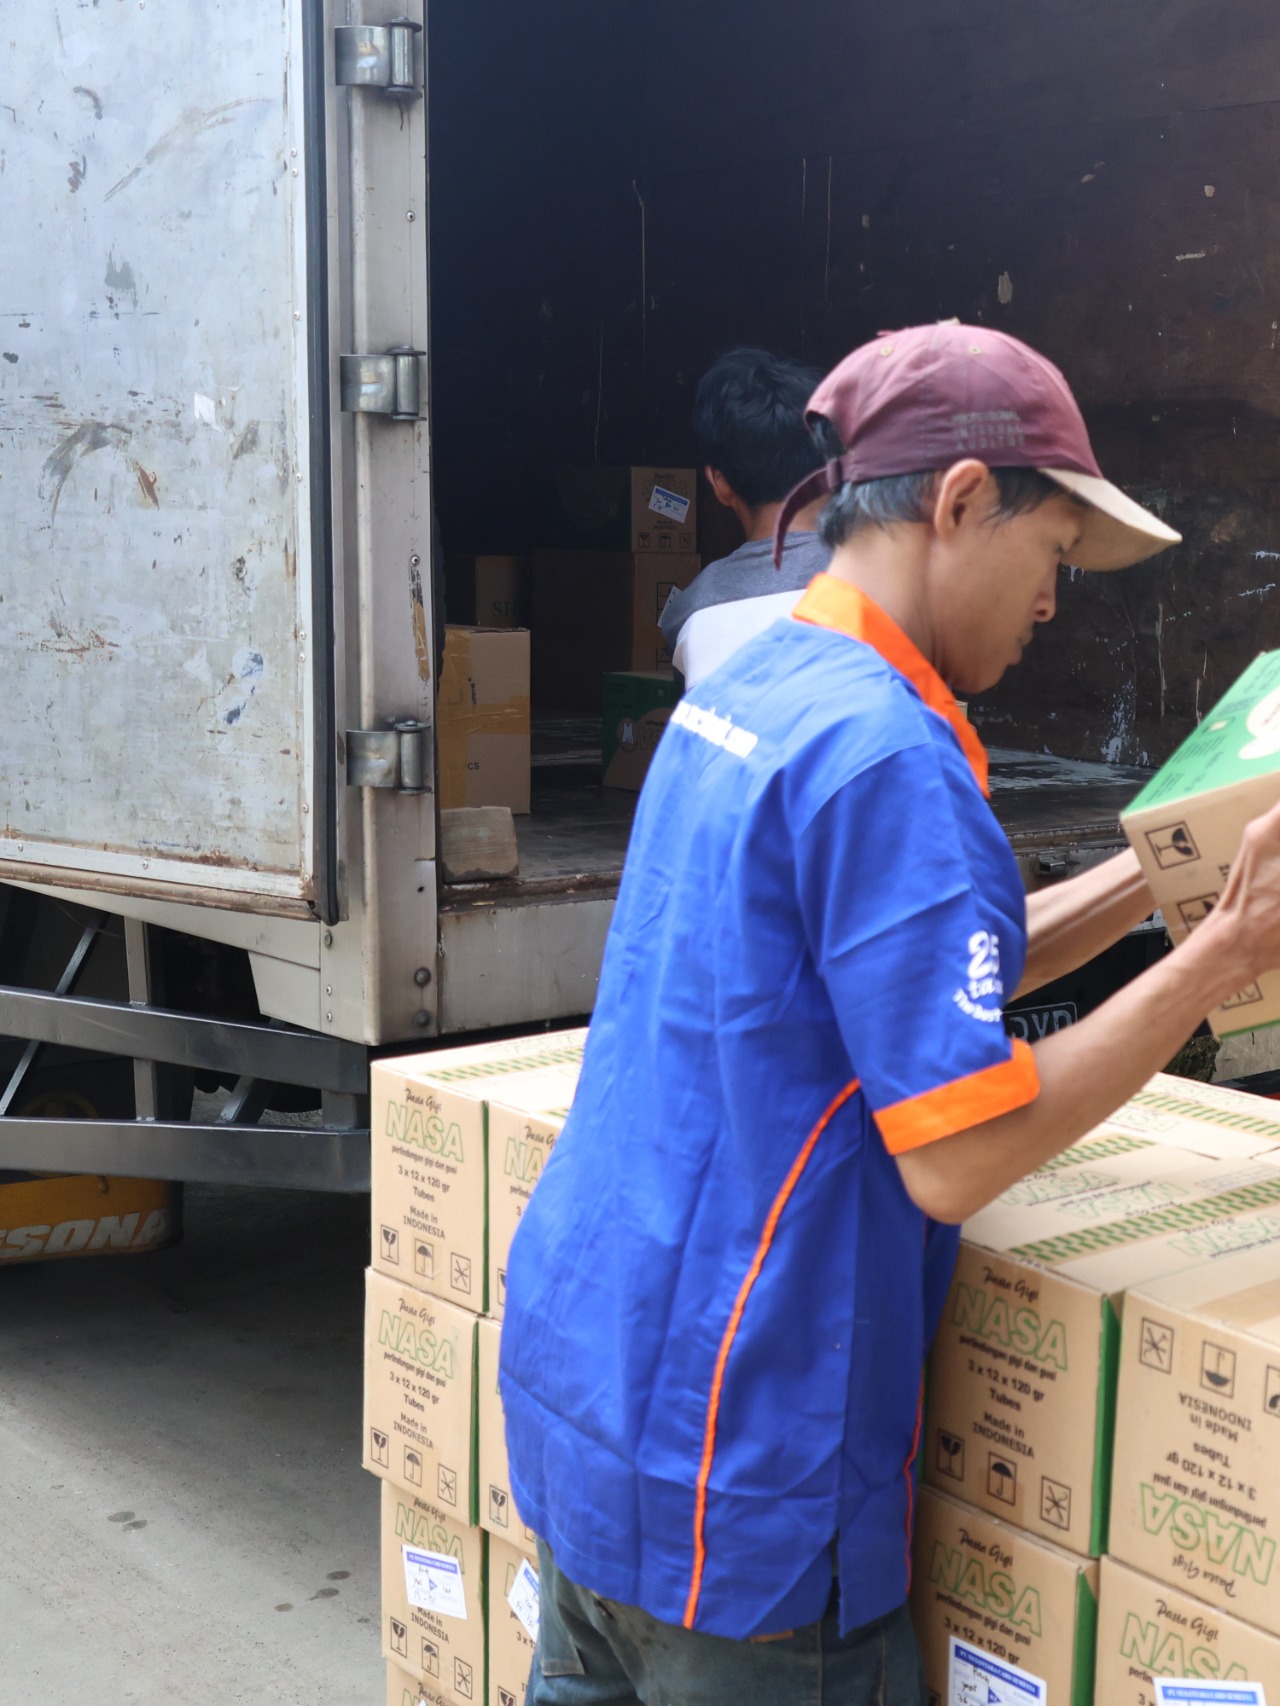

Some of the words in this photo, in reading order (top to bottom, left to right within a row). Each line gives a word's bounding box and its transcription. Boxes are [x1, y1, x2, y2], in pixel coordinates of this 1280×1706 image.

[405, 1088, 424, 1106] Pasta
[426, 1095, 442, 1112] Gigi
[386, 1100, 464, 1163] NASA
[524, 1125, 545, 1144] Pasta
[392, 1144, 424, 1167] perlindungan
[424, 1155, 435, 1168] gigi
[435, 1158, 444, 1170] dan
[444, 1161, 457, 1175] gusi
[398, 1165, 402, 1175] 3
[411, 1170, 419, 1182] 12
[427, 1174, 440, 1189] 120
[441, 1183, 450, 1193] gr
[414, 1186, 435, 1203] Tubes
[403, 1215, 445, 1240] INDONESIA
[410, 1206, 428, 1222] Made
[430, 1211, 438, 1224] in
[983, 1266, 1012, 1291] Pasta
[1014, 1280, 1039, 1303] Gigi
[399, 1298, 418, 1317] Pasta
[419, 1308, 435, 1325] Gigi
[951, 1281, 1067, 1371] NASA
[378, 1310, 453, 1379] NASA
[390, 1372, 395, 1381] 3
[402, 1377, 410, 1390] 12
[418, 1383, 430, 1400] 120
[431, 1394, 440, 1405] gr
[989, 1387, 1021, 1412] Tubes
[404, 1394, 425, 1412] Tubes
[1178, 1392, 1252, 1433] INDONESIA
[400, 1413, 419, 1430] Made
[420, 1421, 427, 1433] in
[983, 1411, 1011, 1433] Made
[1015, 1423, 1024, 1439] in
[1190, 1413, 1201, 1426] in
[1205, 1420, 1239, 1444] Made
[393, 1421, 434, 1449] INDONESIA
[972, 1422, 1035, 1459] INDONESIA
[1166, 1452, 1180, 1465] gr
[1182, 1458, 1205, 1478] 120
[1193, 1442, 1231, 1469] Tubes
[1208, 1470, 1215, 1480] x
[1219, 1472, 1234, 1489] 12
[1237, 1482, 1245, 1492] x
[1248, 1487, 1257, 1500] 3
[395, 1502, 465, 1574] NASA
[1140, 1482, 1277, 1586] NASA
[959, 1528, 986, 1553] Pasta
[989, 1544, 1013, 1568] Gigi
[929, 1540, 1042, 1637] NASA
[1203, 1571, 1238, 1599] Pasta
[411, 1612, 449, 1643] INDONESIA
[417, 1607, 434, 1621] Made
[436, 1613, 443, 1627] in
[1156, 1599, 1187, 1626] Pasta
[1191, 1617, 1218, 1642] Gigi
[944, 1616, 951, 1628] 3
[953, 1625, 959, 1634] x
[963, 1626, 975, 1640] 12
[978, 1637, 984, 1646] x
[987, 1637, 1006, 1658] 120
[1008, 1651, 1020, 1666] gr
